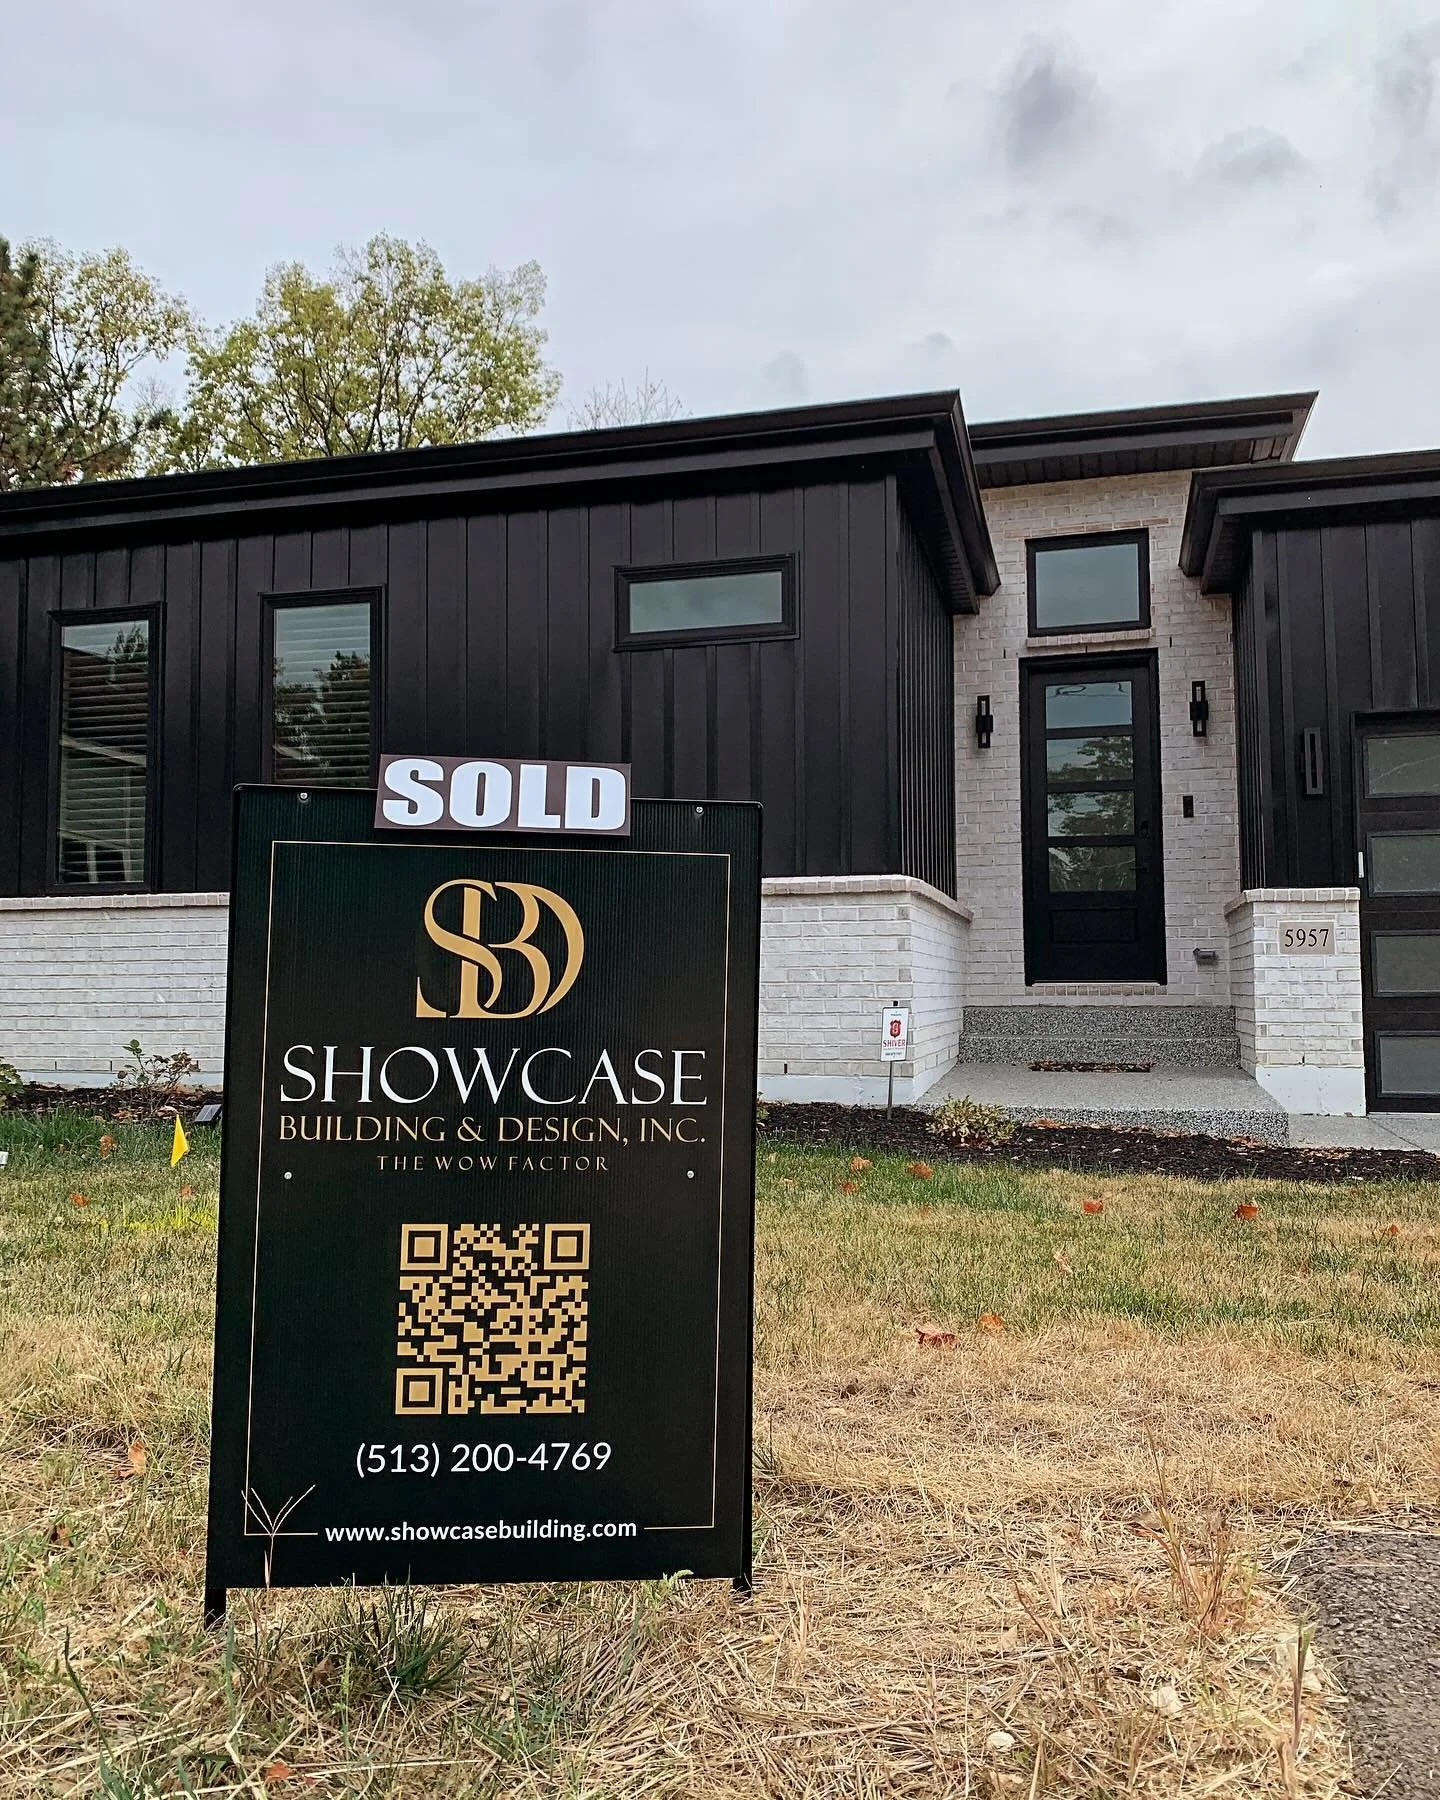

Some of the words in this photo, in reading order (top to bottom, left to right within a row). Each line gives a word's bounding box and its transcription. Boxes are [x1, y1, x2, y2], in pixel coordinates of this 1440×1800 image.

[383, 758, 627, 831] SOLD
[1285, 928, 1329, 947] 5957
[883, 1039, 905, 1047] SHIVER
[280, 1044, 707, 1105] SHOWCASE
[279, 1115, 446, 1142] BUILDING
[457, 1117, 486, 1142] &
[498, 1117, 629, 1148] DESIGN,
[640, 1118, 706, 1143] INC.
[377, 1155, 424, 1171] THE
[434, 1156, 497, 1171] WOW
[508, 1156, 609, 1171] FACTOR
[356, 1442, 440, 1478] (513)
[452, 1441, 612, 1472] 200-4769
[325, 1517, 637, 1544] www.showcasebuilding.com
